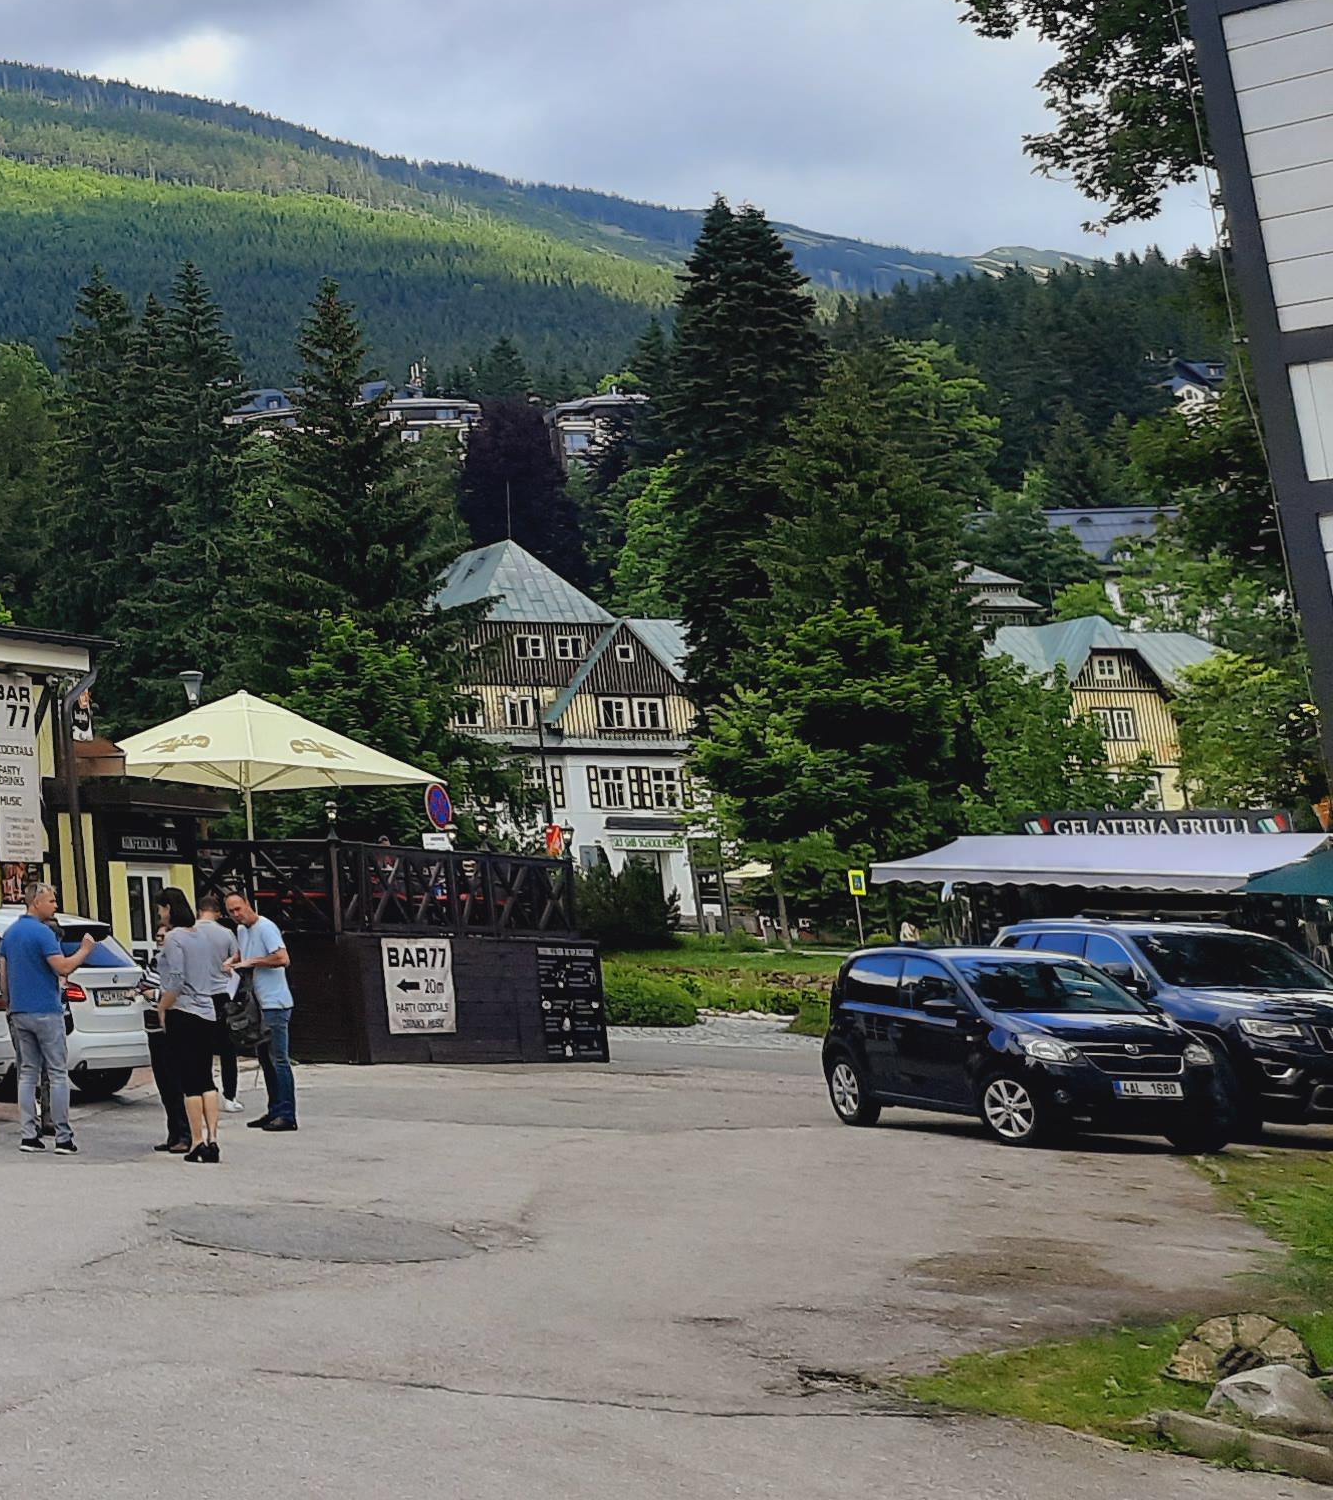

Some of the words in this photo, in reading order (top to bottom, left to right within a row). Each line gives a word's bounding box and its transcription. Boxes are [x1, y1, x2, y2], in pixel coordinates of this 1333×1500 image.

[7, 704, 30, 728] 77
[1053, 818, 1171, 835] GELATERIA
[1177, 818, 1250, 835] FRIULI
[387, 947, 446, 968] BAR77
[424, 979, 445, 994] 20m
